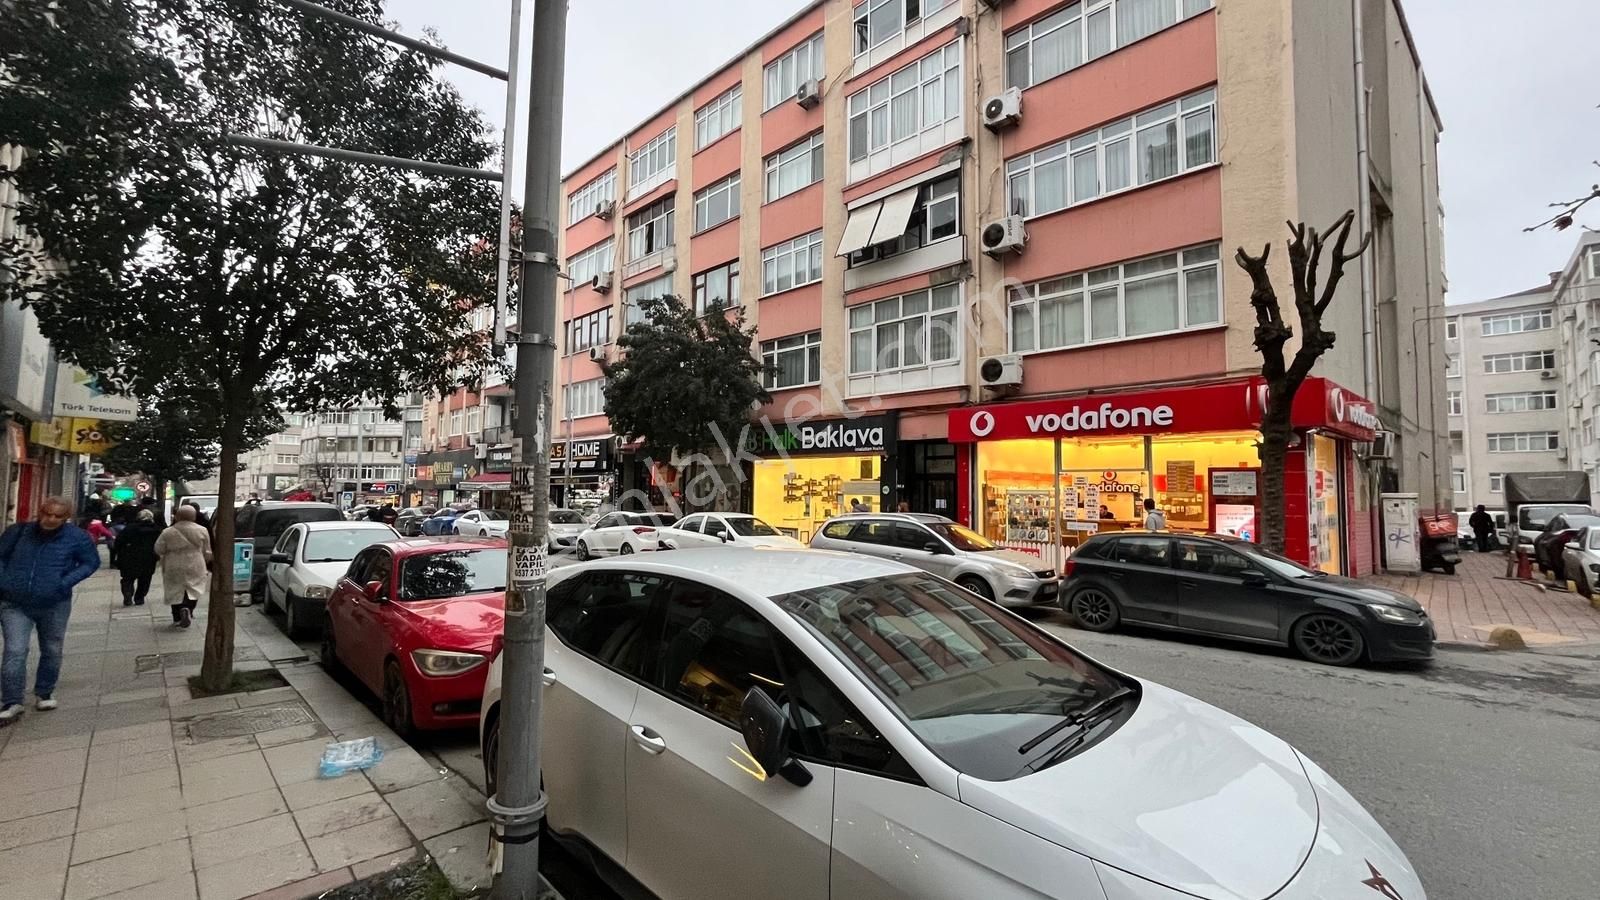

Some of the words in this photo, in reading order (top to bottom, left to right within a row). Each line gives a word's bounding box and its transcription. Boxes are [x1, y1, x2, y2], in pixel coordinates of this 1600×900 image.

[62, 403, 84, 411] Türk
[88, 405, 132, 415] Telekom
[1025, 402, 1174, 433] vodafone
[801, 423, 884, 449] Baklava
[571, 441, 600, 457] HOME
